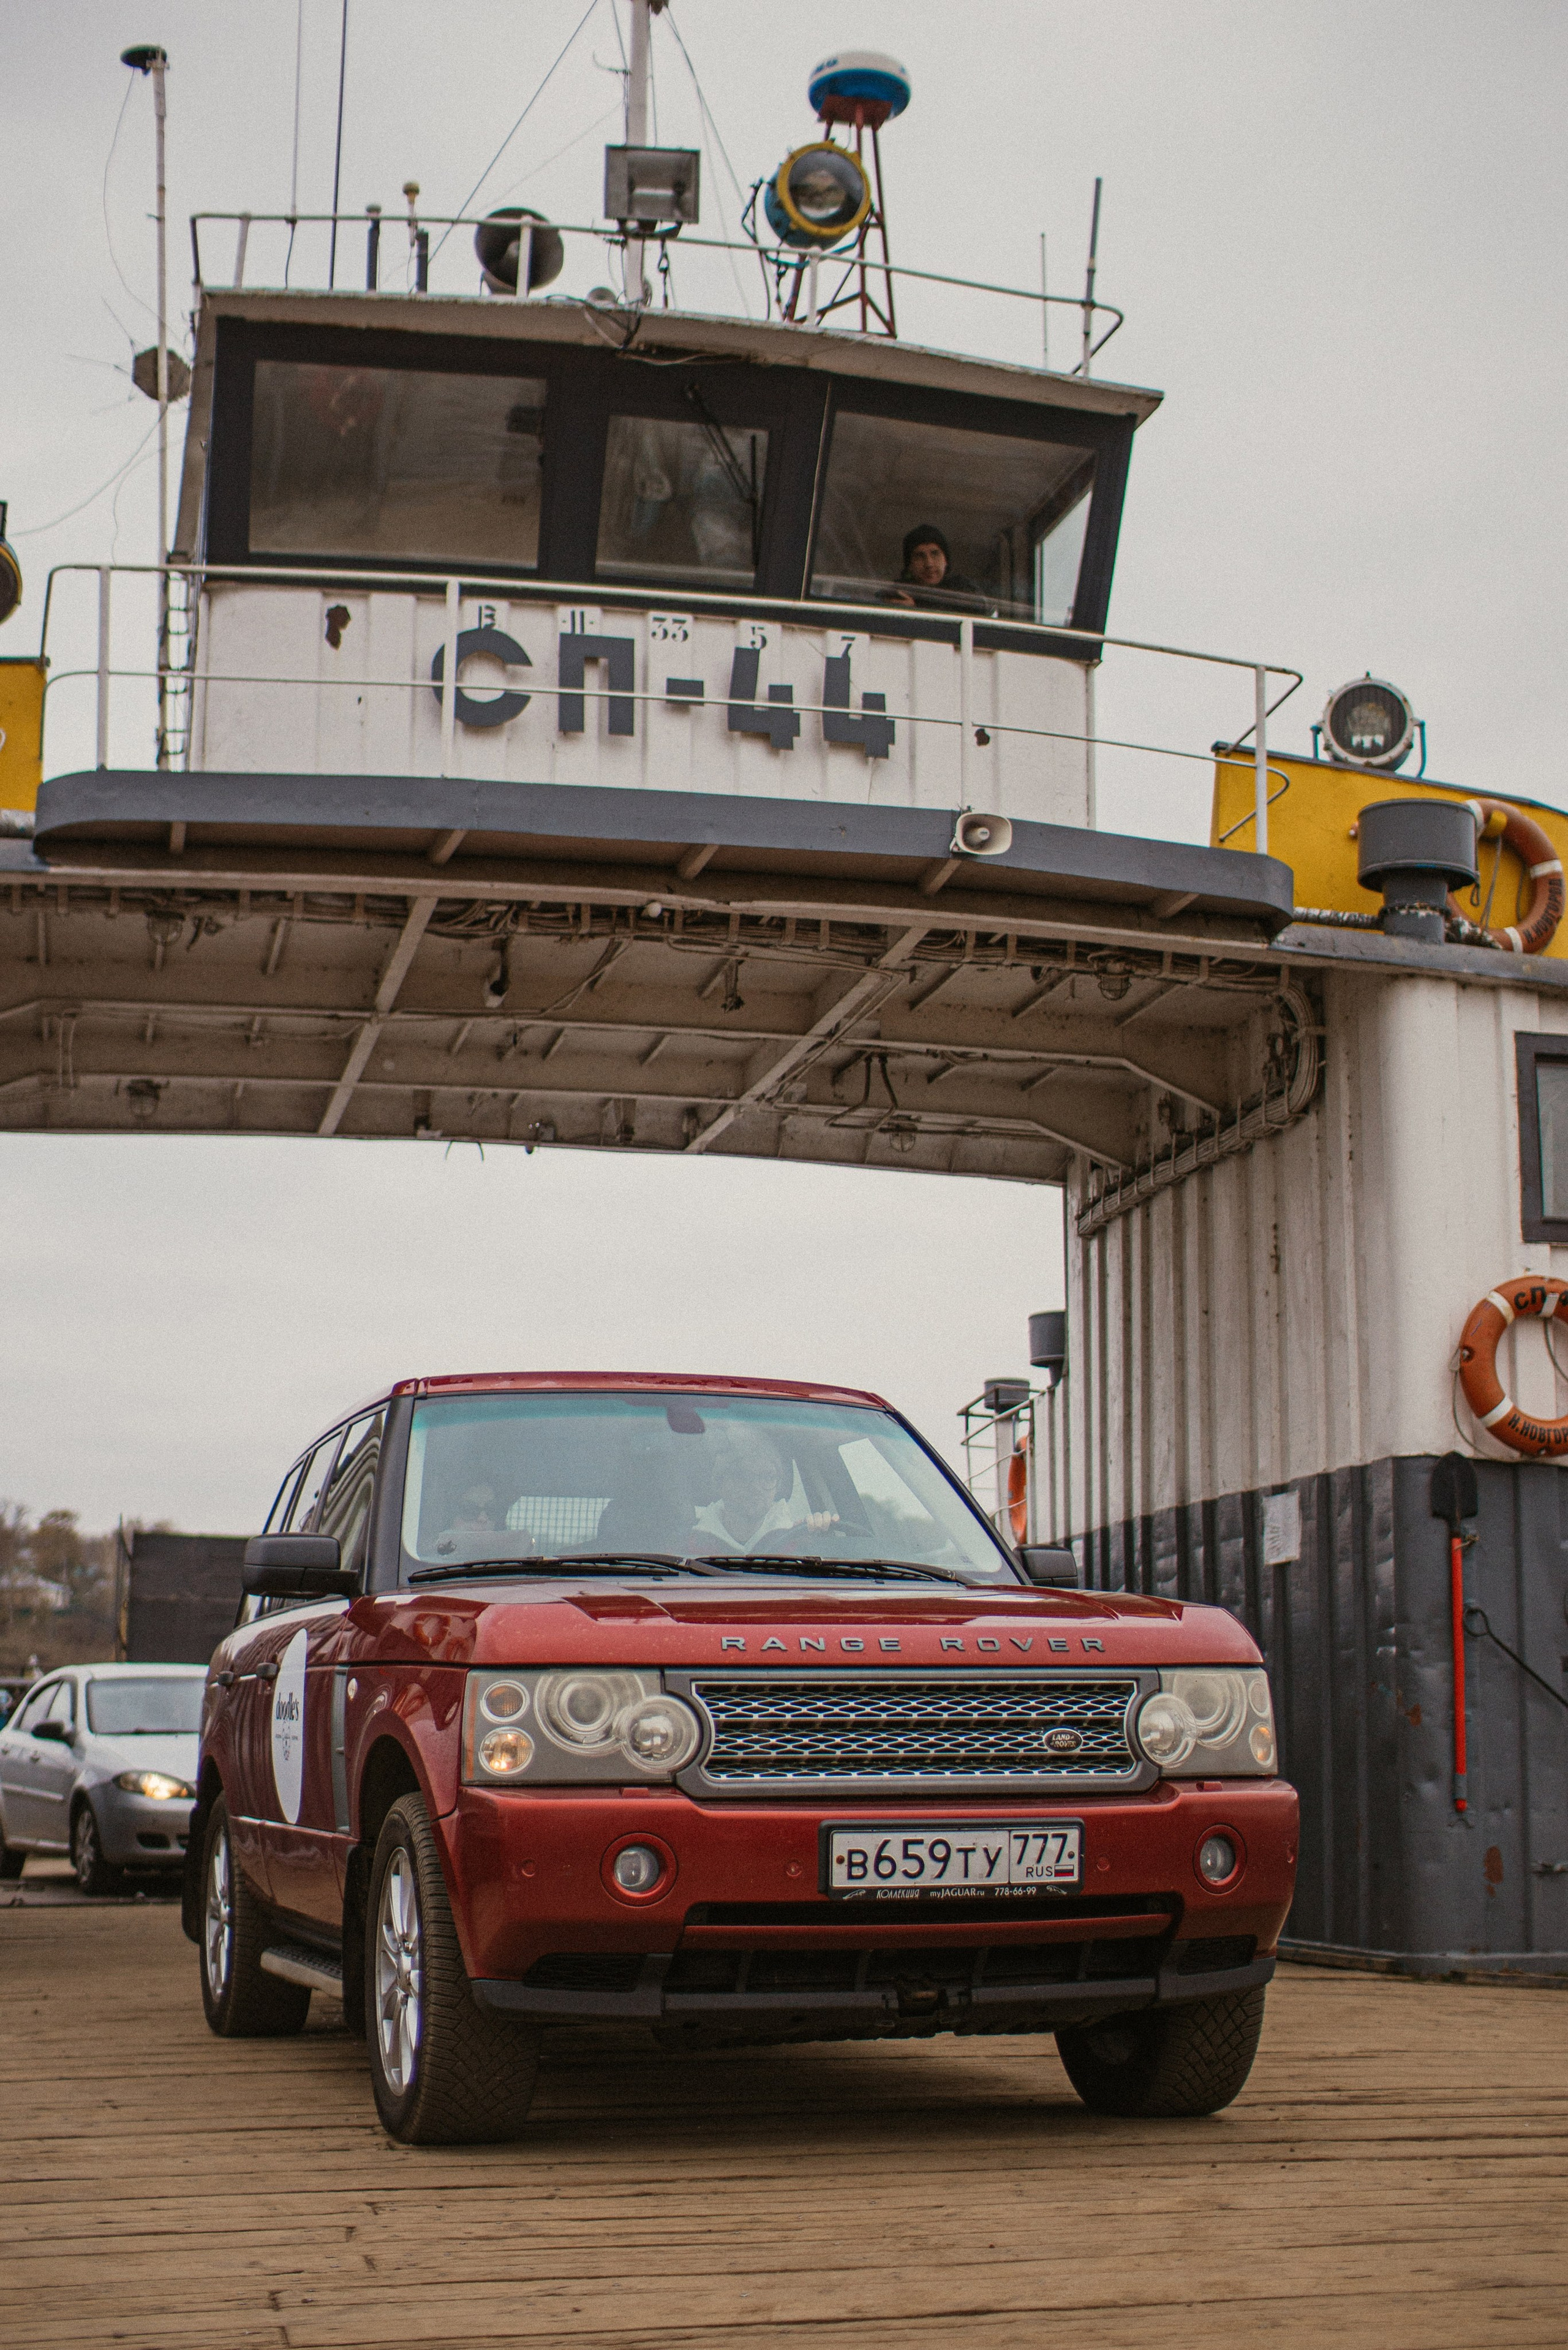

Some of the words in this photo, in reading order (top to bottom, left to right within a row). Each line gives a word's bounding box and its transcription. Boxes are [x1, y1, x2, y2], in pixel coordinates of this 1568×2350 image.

[651, 616, 688, 642] 33
[750, 626, 768, 650] 5
[431, 627, 895, 759] СП-44
[720, 1636, 902, 1651] RANGE
[940, 1636, 1106, 1652] ROVER
[1012, 1832, 1069, 1865] 777
[1025, 1866, 1053, 1878] RUS
[930, 1887, 985, 1899] myJAGUAR.ru
[994, 1886, 1037, 1896] 778-66-99
